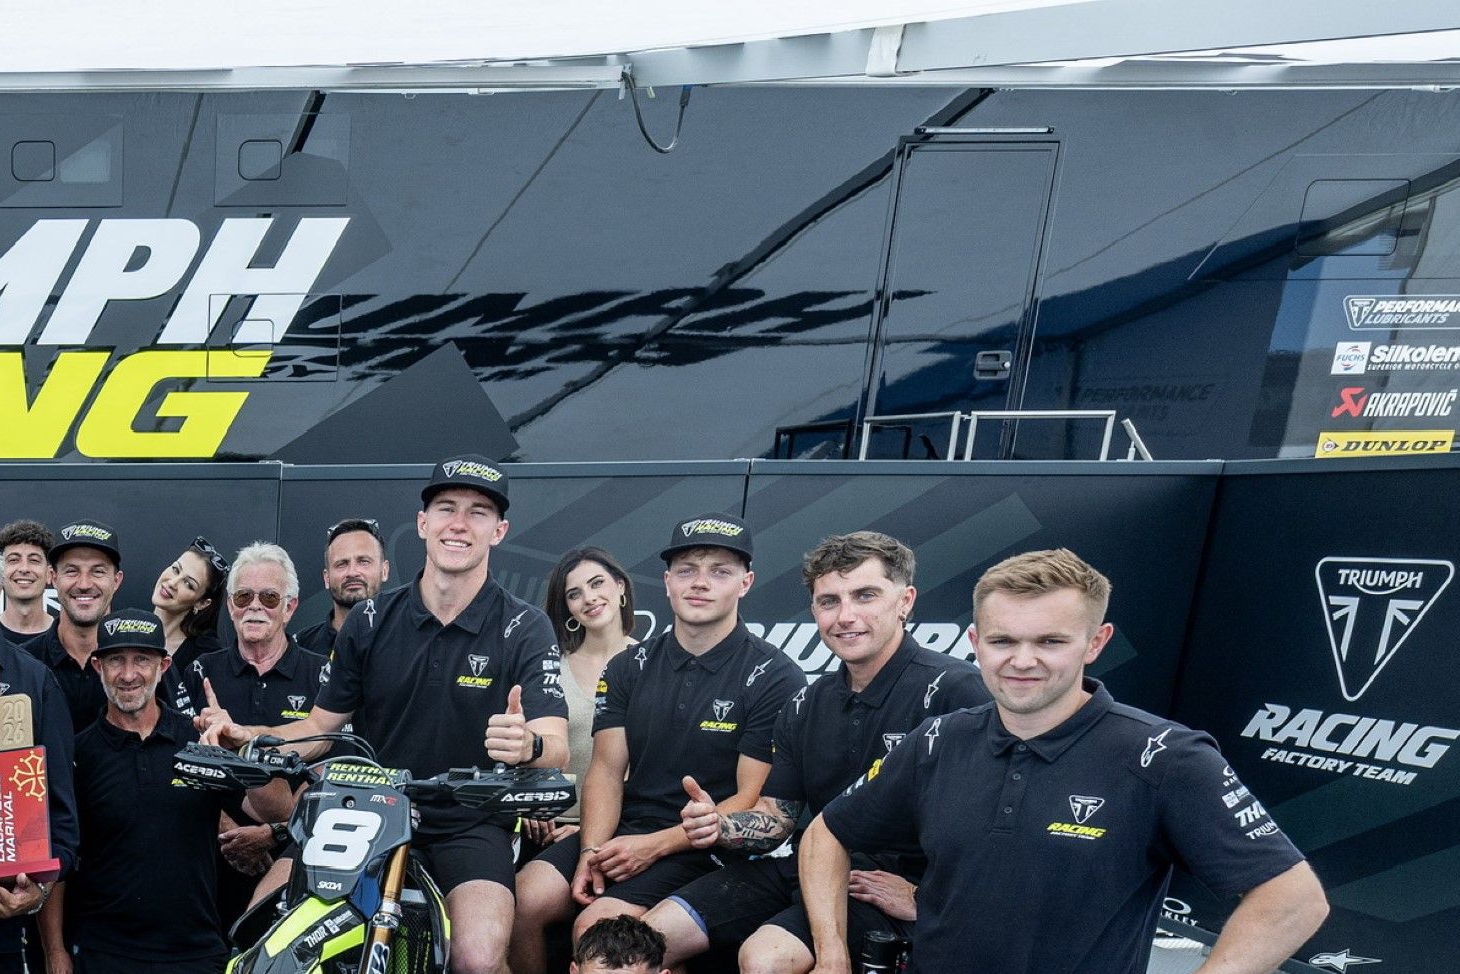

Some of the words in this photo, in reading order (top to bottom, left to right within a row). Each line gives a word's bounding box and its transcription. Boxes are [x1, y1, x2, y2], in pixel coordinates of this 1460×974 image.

[1365, 313, 1450, 324] LUBRICANTS
[1336, 353, 1366, 362] FUCHS
[1341, 440, 1448, 452] DUNLOP
[1337, 569, 1424, 590] TRIUMPH
[456, 675, 494, 687] RACING
[699, 720, 738, 731] RACING
[1240, 703, 1460, 768] RACING
[174, 762, 227, 779] ACERBIS
[1261, 747, 1354, 774] FACTORY
[1355, 763, 1418, 785] TEAM
[500, 791, 571, 802] ACERBIS
[3, 790, 17, 862] MARIVAL
[1047, 822, 1107, 838] RACING
[302, 808, 382, 871] 8
[1160, 910, 1198, 927] KLEY
